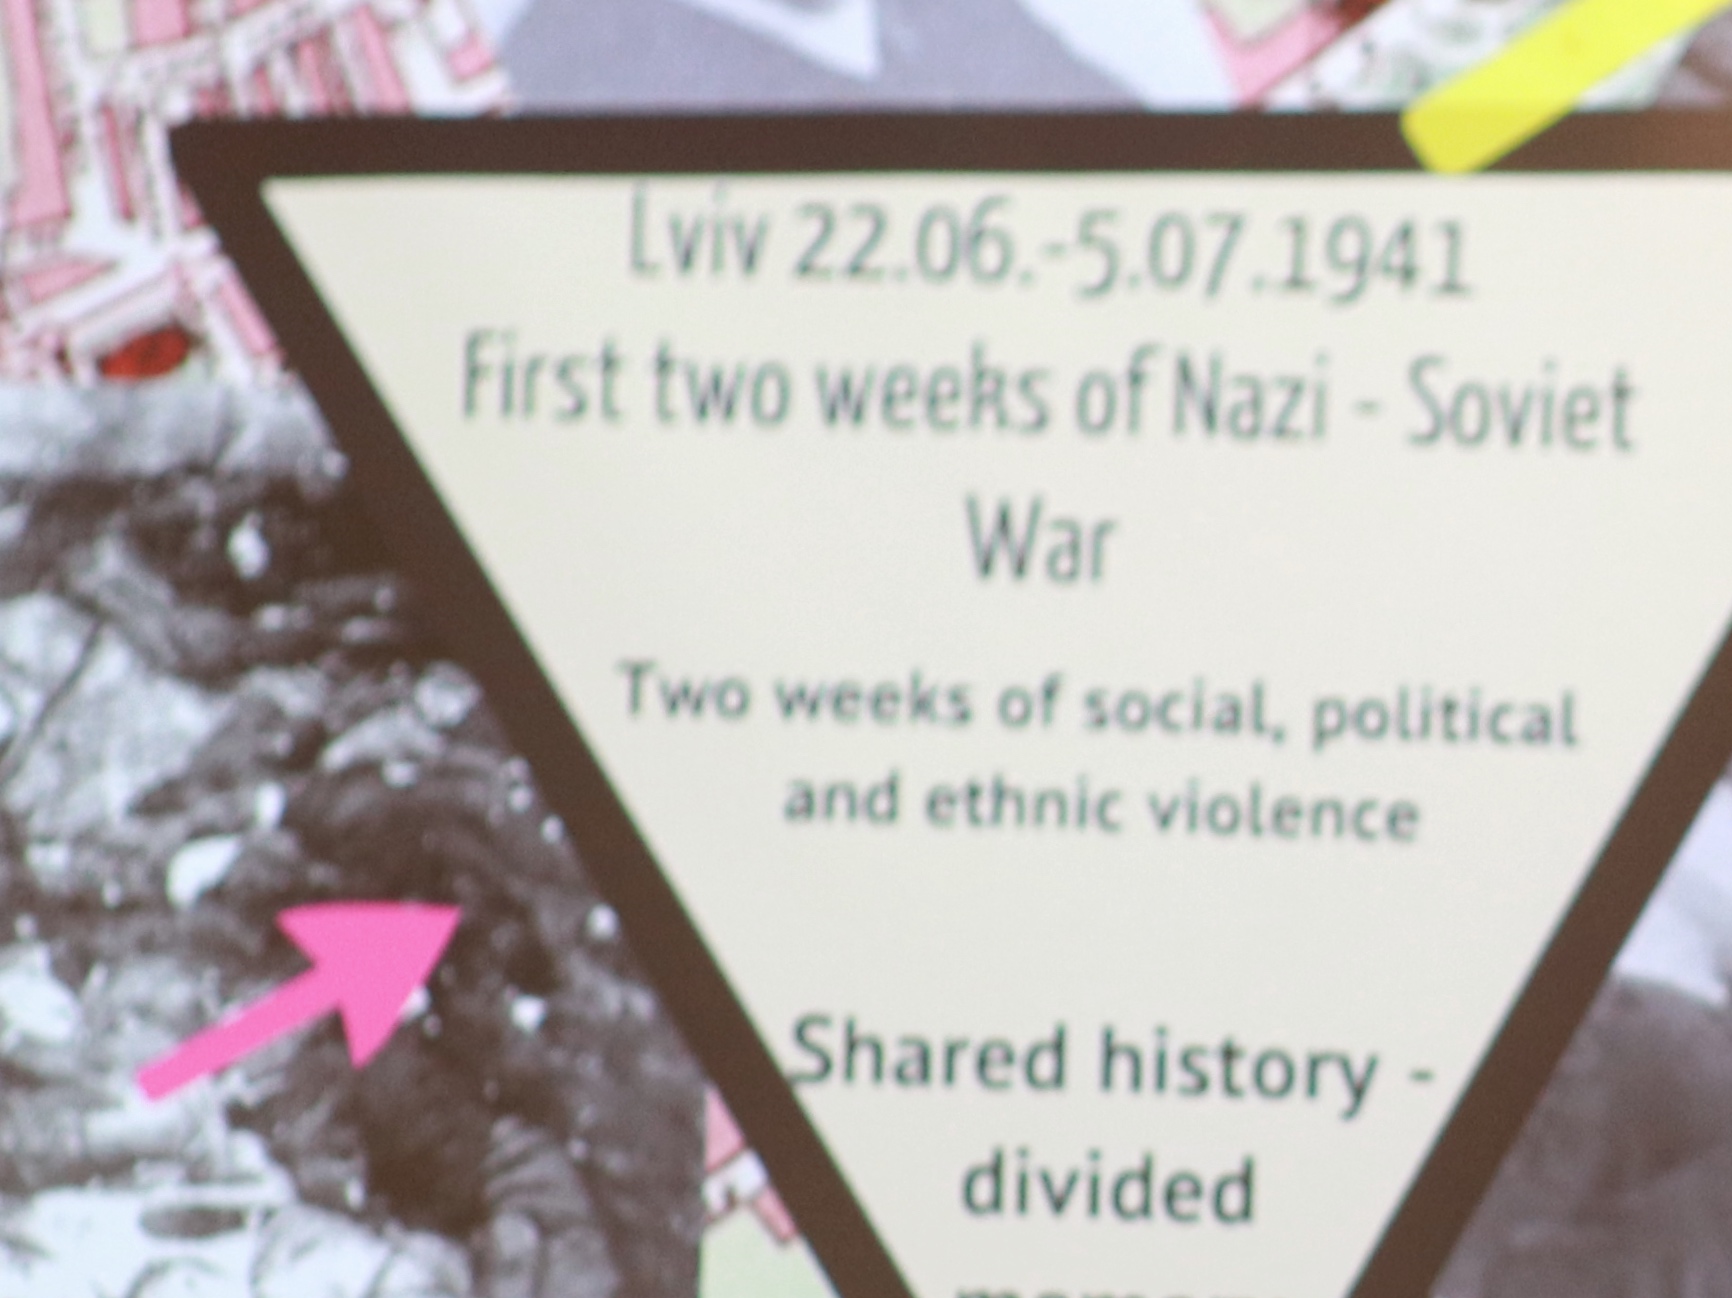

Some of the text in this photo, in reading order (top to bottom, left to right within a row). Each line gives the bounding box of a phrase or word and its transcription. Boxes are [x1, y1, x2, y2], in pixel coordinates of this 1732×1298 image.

[627, 183, 1472, 309] Lviv 22.06.-5.07.1941
[460, 326, 624, 425] First
[651, 341, 794, 429] two
[812, 342, 1053, 437] weeks
[1072, 341, 1160, 439] of
[1170, 350, 1328, 444] Nazi
[1405, 352, 1637, 455] Soviet
[963, 494, 1116, 586] War
[617, 658, 1581, 755] Two weeks of social, political
[781, 770, 1423, 845] and ethnic violence
[791, 1012, 1069, 1091] Shared
[1098, 1024, 1381, 1123] history
[959, 1146, 1257, 1227] divided
